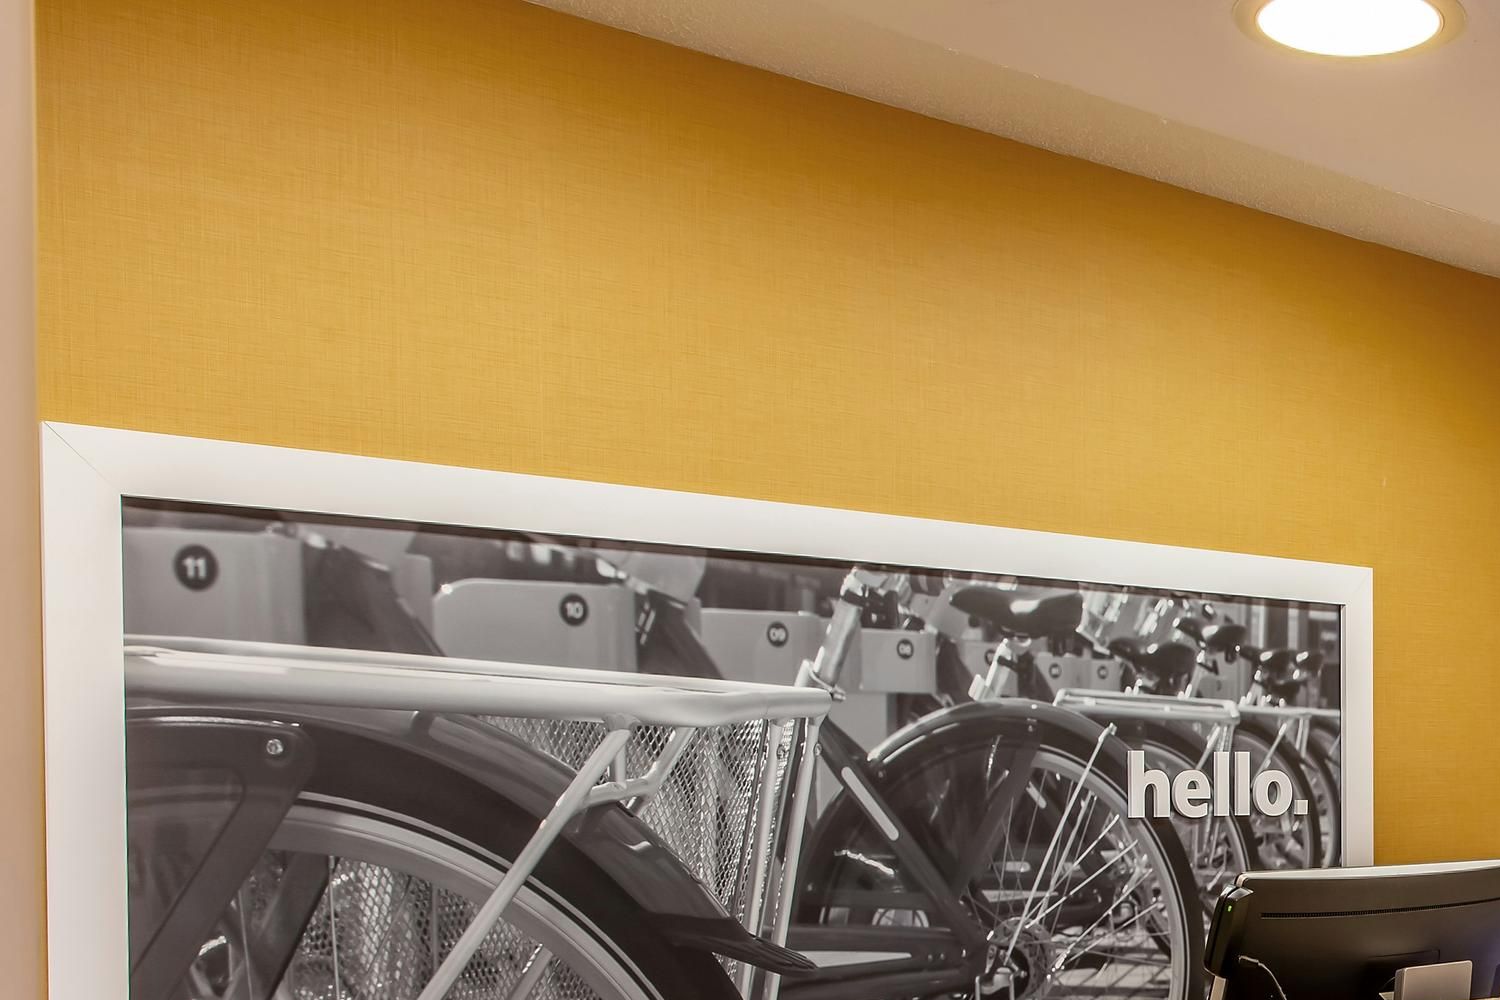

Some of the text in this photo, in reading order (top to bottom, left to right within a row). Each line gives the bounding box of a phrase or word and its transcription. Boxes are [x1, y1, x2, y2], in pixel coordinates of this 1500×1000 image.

[182, 556, 206, 580] 11
[565, 601, 584, 619] 10
[769, 627, 786, 642] 09
[1127, 750, 1309, 818] hello.
